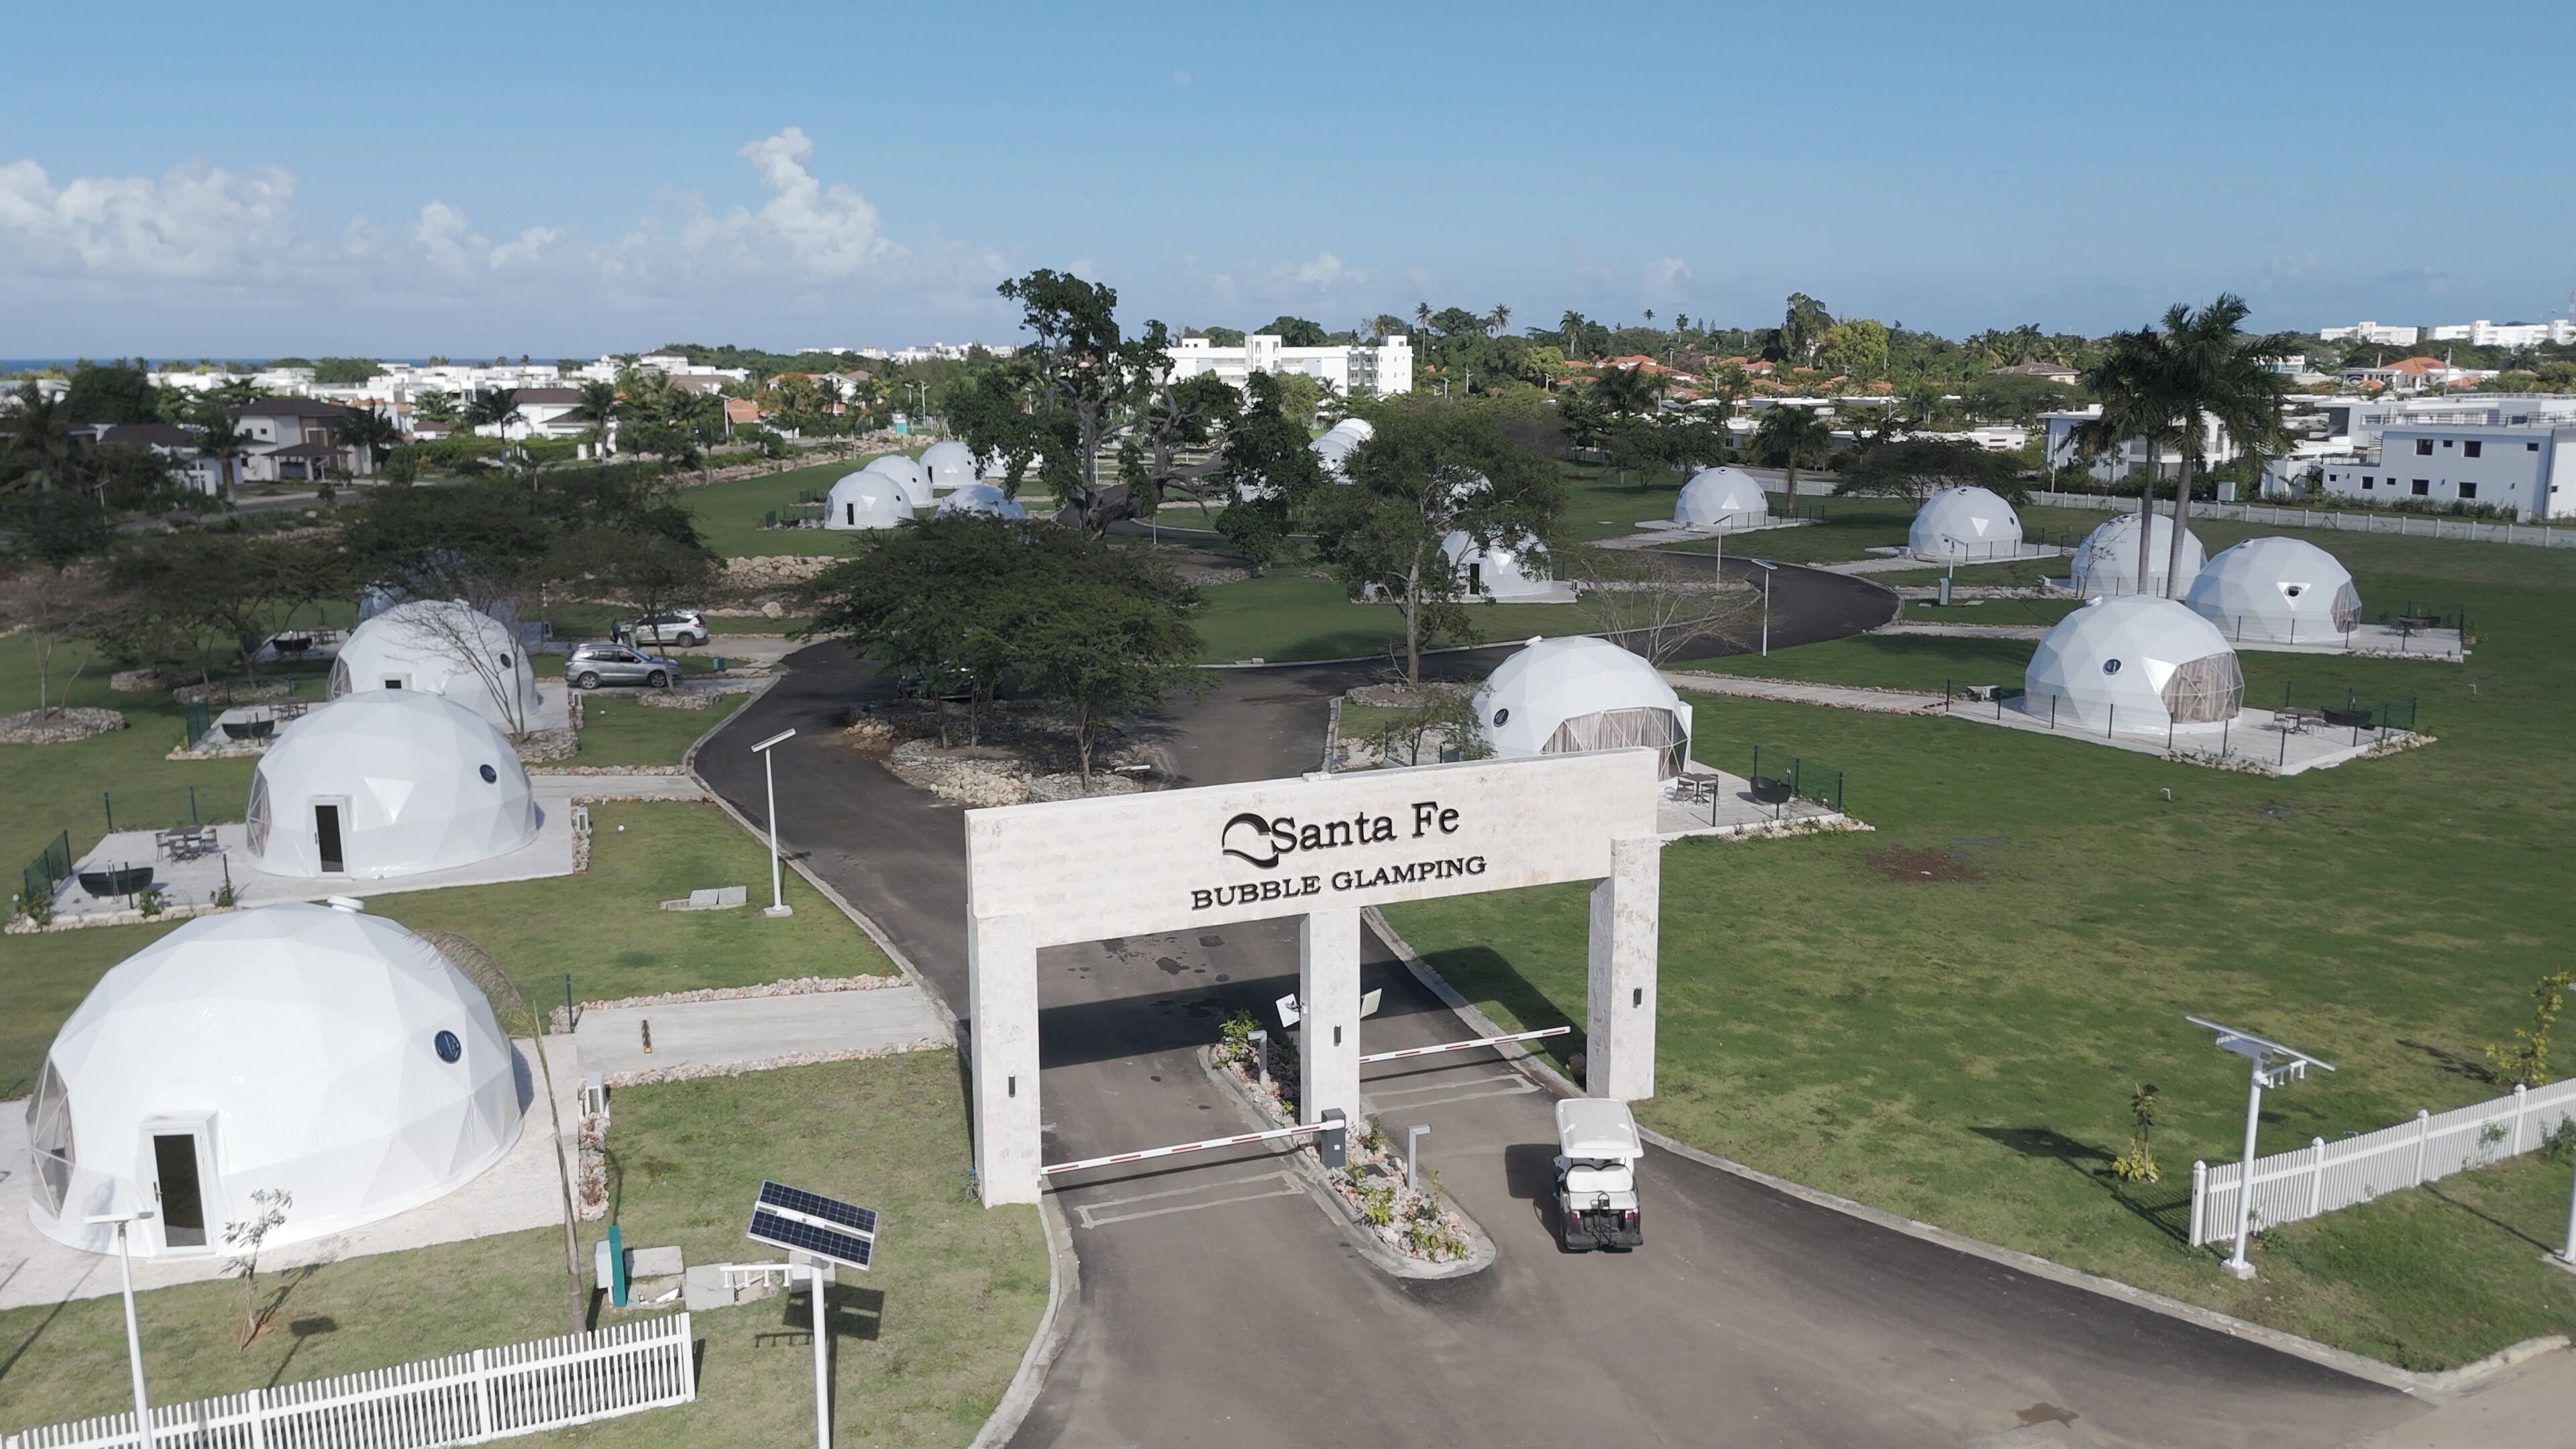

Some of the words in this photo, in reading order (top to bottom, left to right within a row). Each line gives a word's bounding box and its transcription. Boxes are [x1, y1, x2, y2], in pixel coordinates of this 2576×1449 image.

[1271, 811, 1397, 853] Santa
[1411, 801, 1460, 838] Fe
[1191, 875, 1321, 910] BUBBLE
[1332, 855, 1487, 892] GLAMPING
